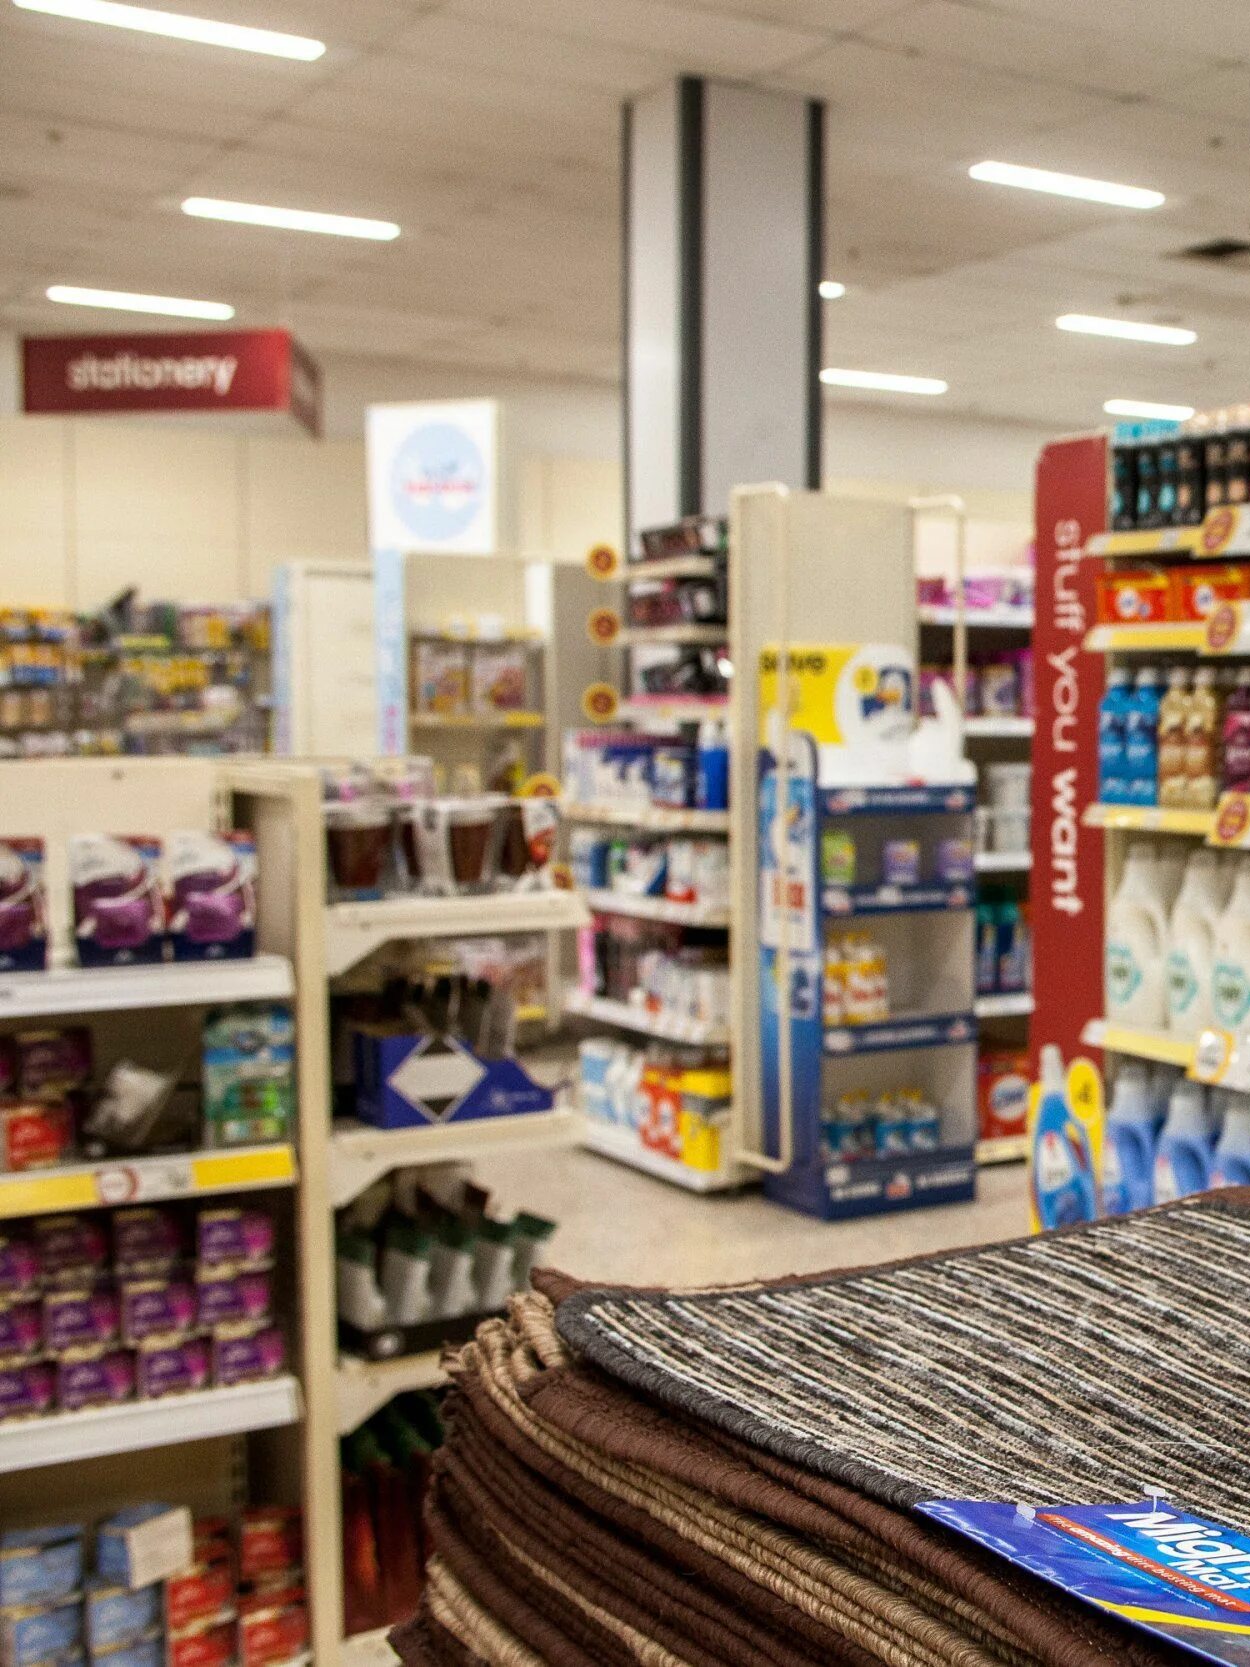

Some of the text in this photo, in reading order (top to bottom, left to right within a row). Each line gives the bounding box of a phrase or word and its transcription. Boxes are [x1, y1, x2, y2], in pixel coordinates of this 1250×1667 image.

[66, 351, 238, 397] stationery
[1047, 519, 1086, 917] stuff you want
[1069, 1526, 1133, 1557] amazing
[1152, 1567, 1206, 1593] busting
[1205, 1591, 1237, 1606] mat
